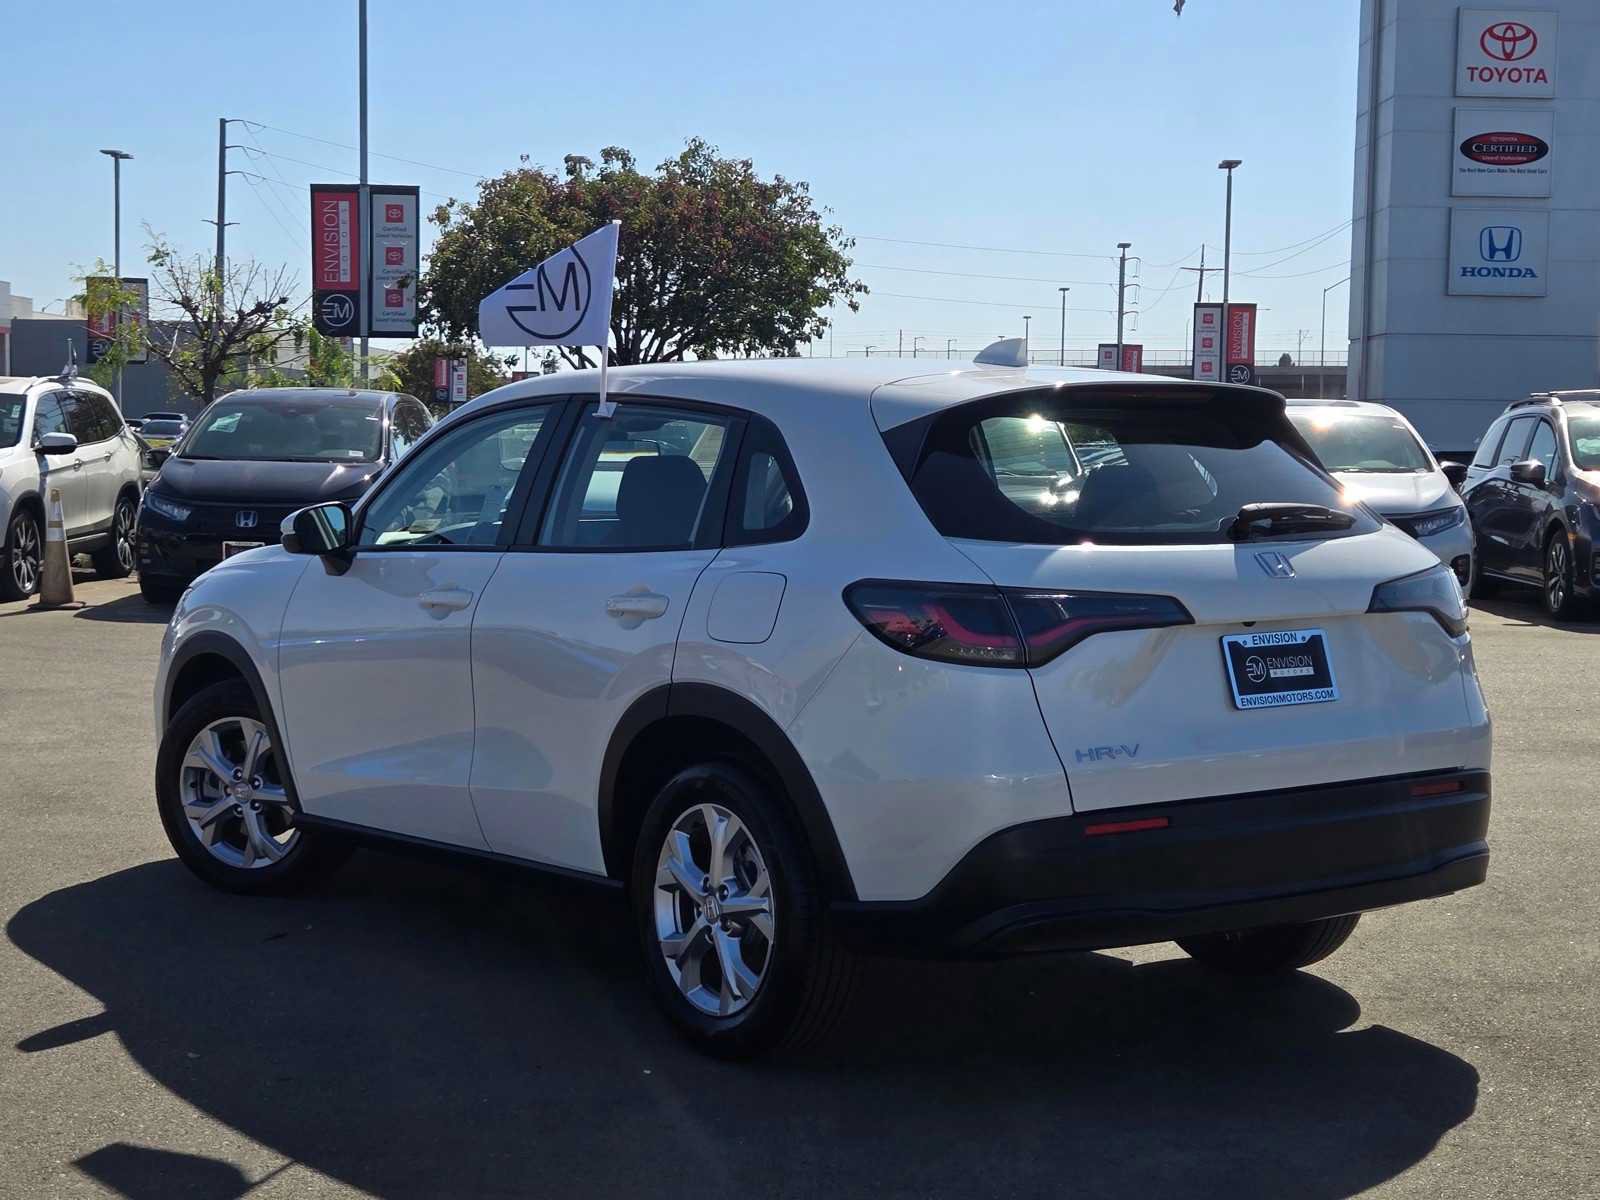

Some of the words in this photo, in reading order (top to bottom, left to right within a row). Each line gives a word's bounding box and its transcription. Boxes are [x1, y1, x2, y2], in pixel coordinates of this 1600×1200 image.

[1466, 66, 1548, 84] TOYOTA
[1472, 143, 1537, 153] CERTIFIED
[323, 200, 339, 283] ENVISION
[1460, 266, 1538, 278] HONDA
[1232, 311, 1243, 360] ENVISION
[1251, 633, 1298, 646] ENVISION
[1266, 655, 1313, 669] ENVISION
[1241, 689, 1335, 707] ENVISIONMOTORS.COM
[1075, 743, 1140, 763] HR-V
